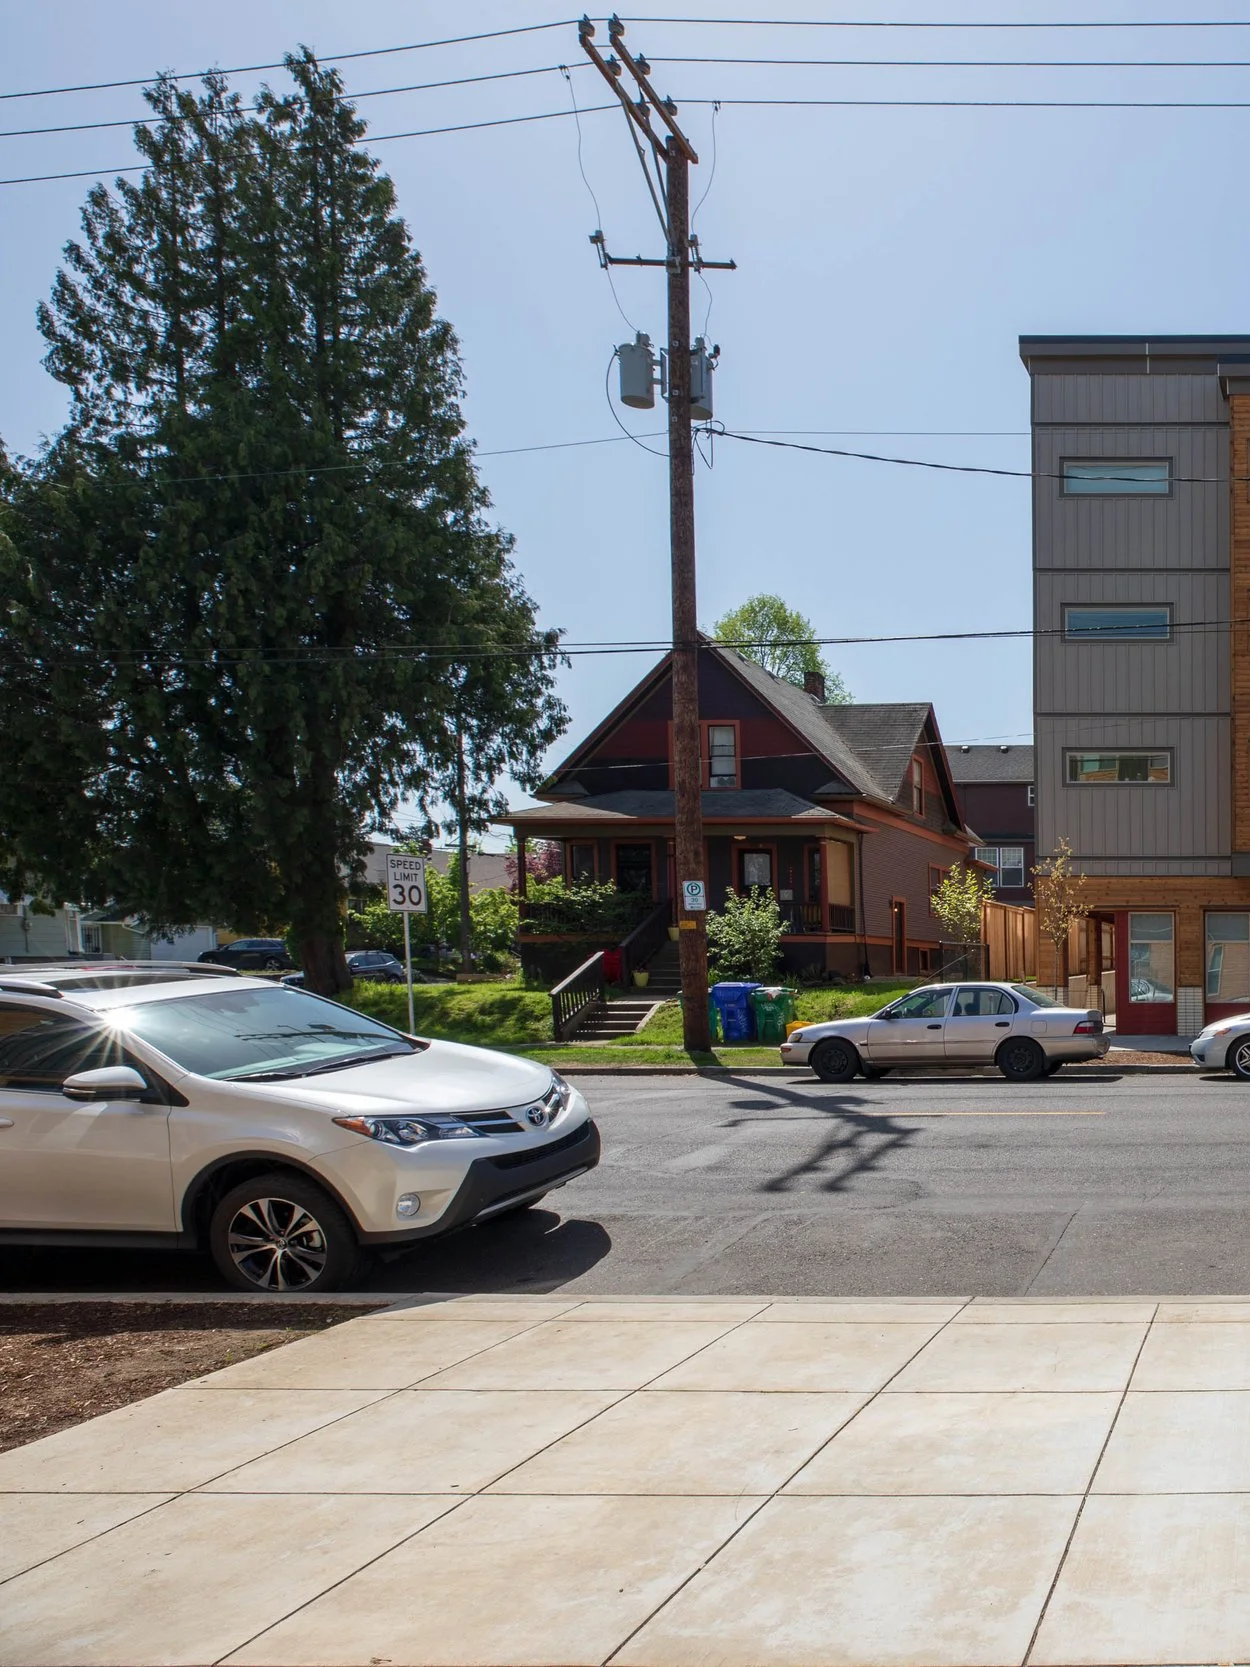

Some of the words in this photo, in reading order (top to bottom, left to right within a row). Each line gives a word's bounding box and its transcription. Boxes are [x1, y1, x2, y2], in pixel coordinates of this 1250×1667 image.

[390, 859, 421, 870] SPEED
[393, 871, 418, 882] LIMIT
[690, 885, 698, 893] P
[392, 884, 422, 906] 30
